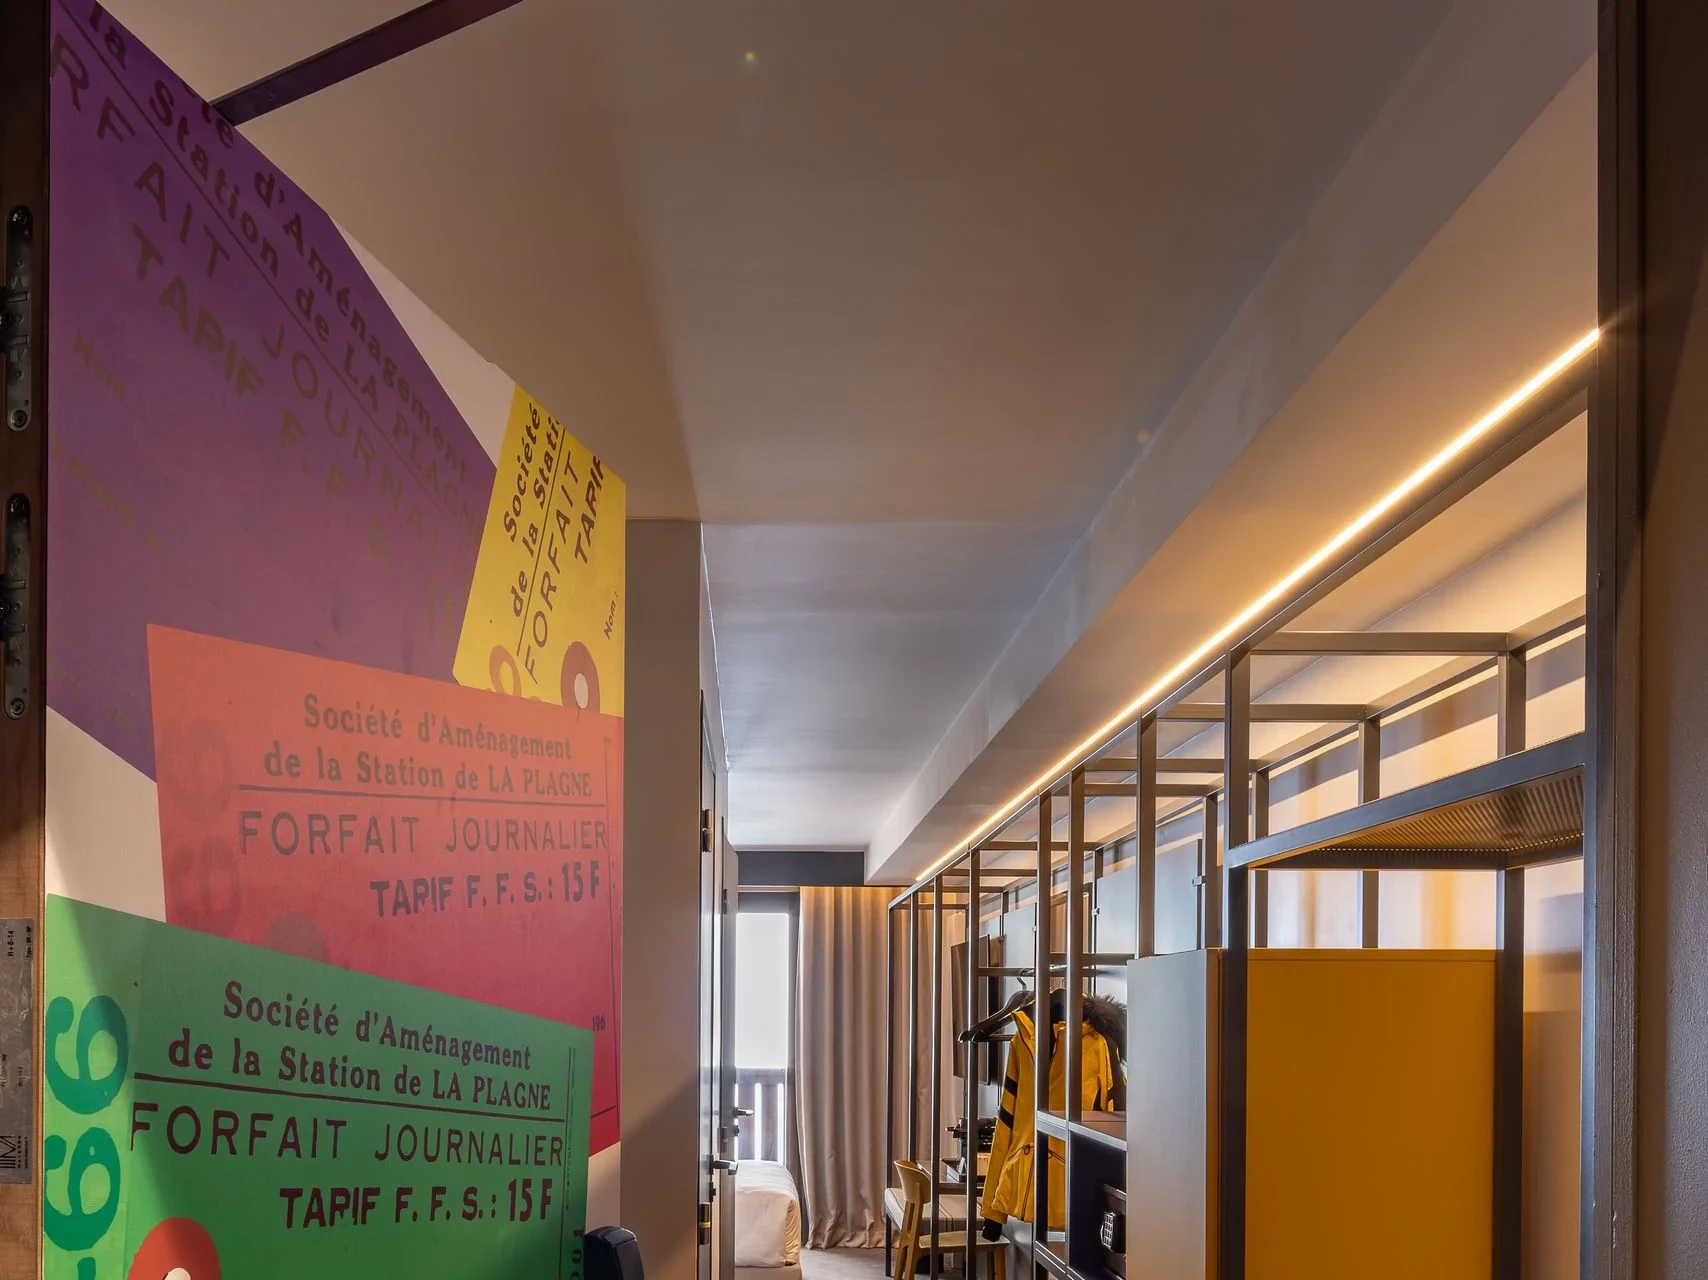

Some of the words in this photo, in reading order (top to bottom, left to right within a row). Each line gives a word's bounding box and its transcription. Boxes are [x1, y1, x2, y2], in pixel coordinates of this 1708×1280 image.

[148, 79, 279, 279] Station
[295, 286, 331, 343] de
[343, 341, 379, 413] LA
[132, 222, 265, 398] TARIF
[504, 401, 540, 544] Société
[512, 569, 528, 619] de
[522, 521, 538, 560] la
[533, 415, 560, 509] Stati
[524, 449, 580, 686] FORFAIT
[603, 599, 617, 641] Nom
[303, 693, 403, 740] Société
[417, 711, 572, 760] d'Aménagement
[264, 740, 302, 778] de
[317, 746, 343, 782] la
[357, 750, 444, 788] Station
[455, 762, 479, 790] de
[488, 764, 515, 793] LA
[523, 767, 593, 798] PLAGNE
[239, 810, 420, 856] FORFAIT
[445, 816, 608, 853] JOURNALIER
[370, 875, 454, 917] TARIF
[561, 860, 585, 903] 15
[590, 860, 601, 899] F
[222, 980, 339, 1037] Société
[355, 1009, 532, 1071] d'Aménagement
[168, 1028, 213, 1070] de
[233, 1037, 261, 1077] la
[278, 1045, 381, 1092] Station
[394, 1065, 422, 1097] de
[432, 1068, 462, 1102] LA
[472, 1073, 552, 1112] PLAGNE
[130, 1101, 348, 1160] FORFAIT
[374, 1123, 564, 1167] JOURNALIER
[279, 1186, 381, 1230] TARIF
[507, 1178, 533, 1223] 15
[540, 1178, 554, 1221] F
